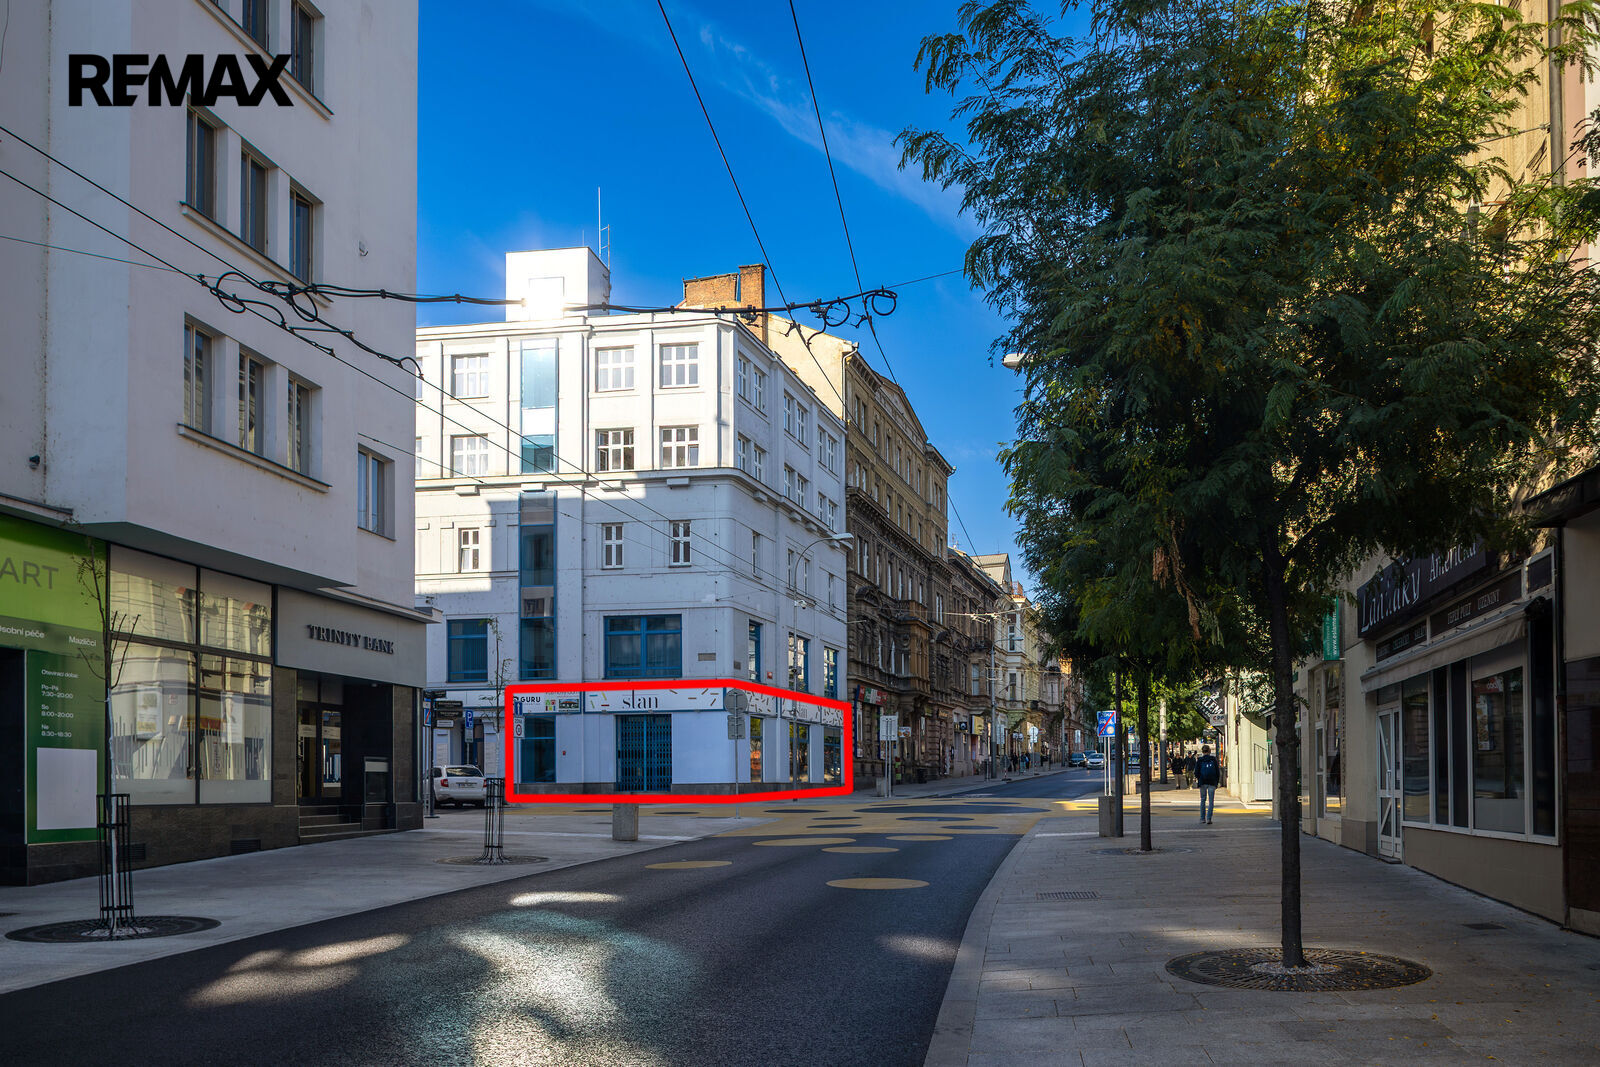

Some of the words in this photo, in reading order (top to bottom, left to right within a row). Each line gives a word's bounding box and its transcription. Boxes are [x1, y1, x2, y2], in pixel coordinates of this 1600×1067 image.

[0, 557, 59, 590] ART
[25, 627, 45, 639] péče
[69, 635, 97, 647] Mazlíčci
[306, 624, 361, 647] TRINITY
[363, 636, 394, 654] BANK
[622, 689, 658, 709] stan
